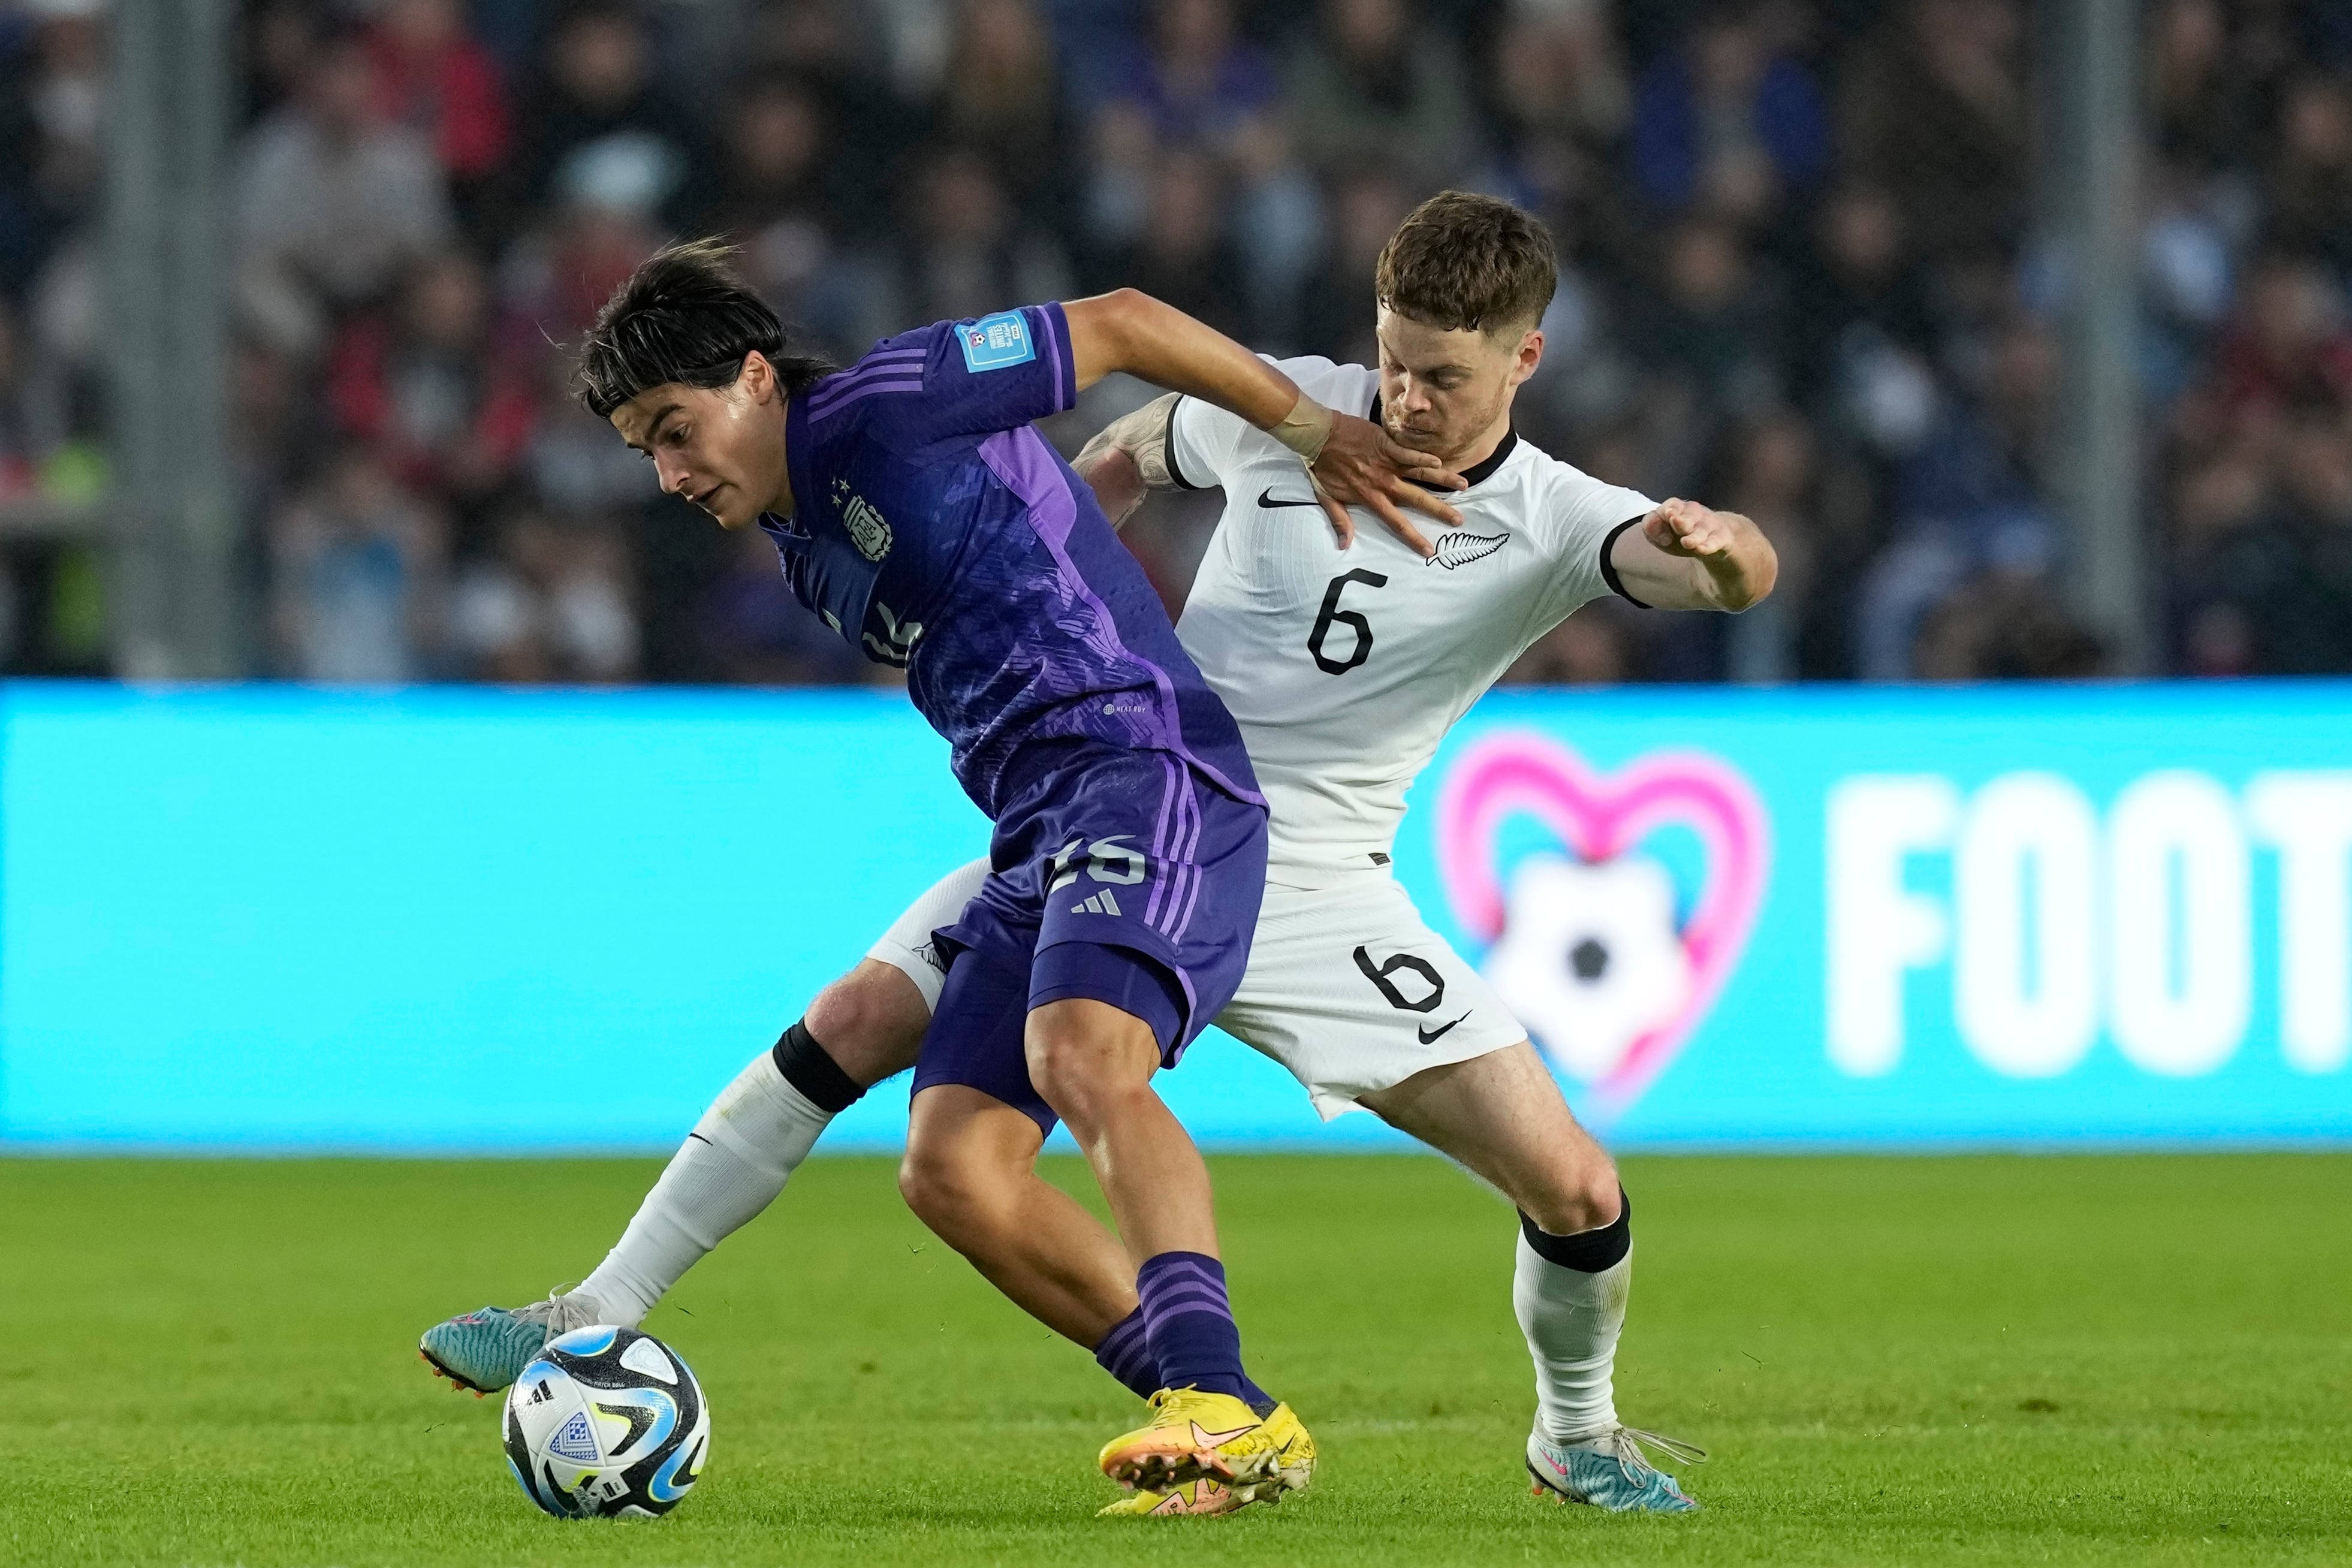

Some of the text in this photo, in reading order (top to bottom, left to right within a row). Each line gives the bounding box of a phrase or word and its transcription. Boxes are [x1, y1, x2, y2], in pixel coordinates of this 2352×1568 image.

[1307, 568, 1388, 675] 6
[1825, 769, 2352, 1078] FOOT
[1353, 945, 1445, 1013] 6
